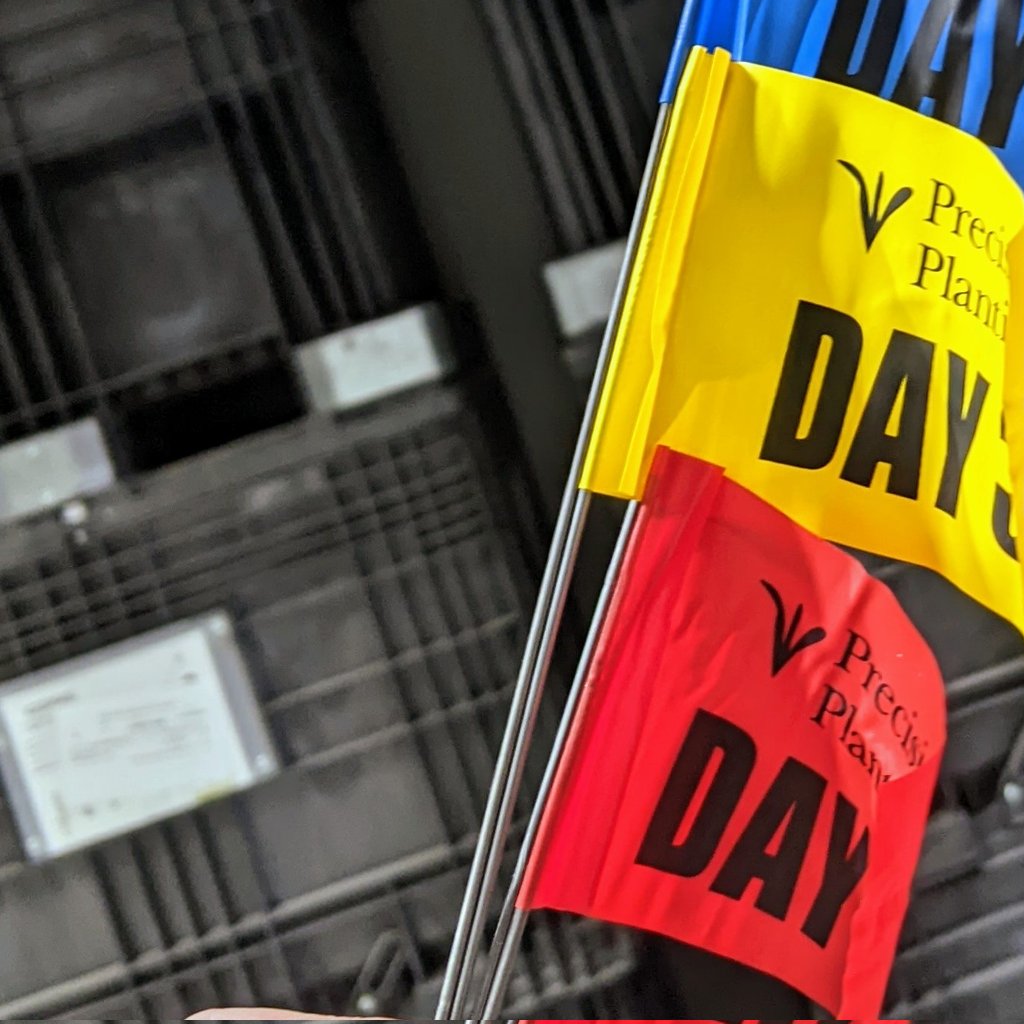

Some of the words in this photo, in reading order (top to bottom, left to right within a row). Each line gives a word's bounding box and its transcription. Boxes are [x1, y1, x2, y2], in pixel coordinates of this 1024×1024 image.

[923, 178, 1008, 278] Preci
[758, 299, 990, 519] DAY
[810, 684, 890, 789] Plan
[634, 707, 870, 949] DAY
